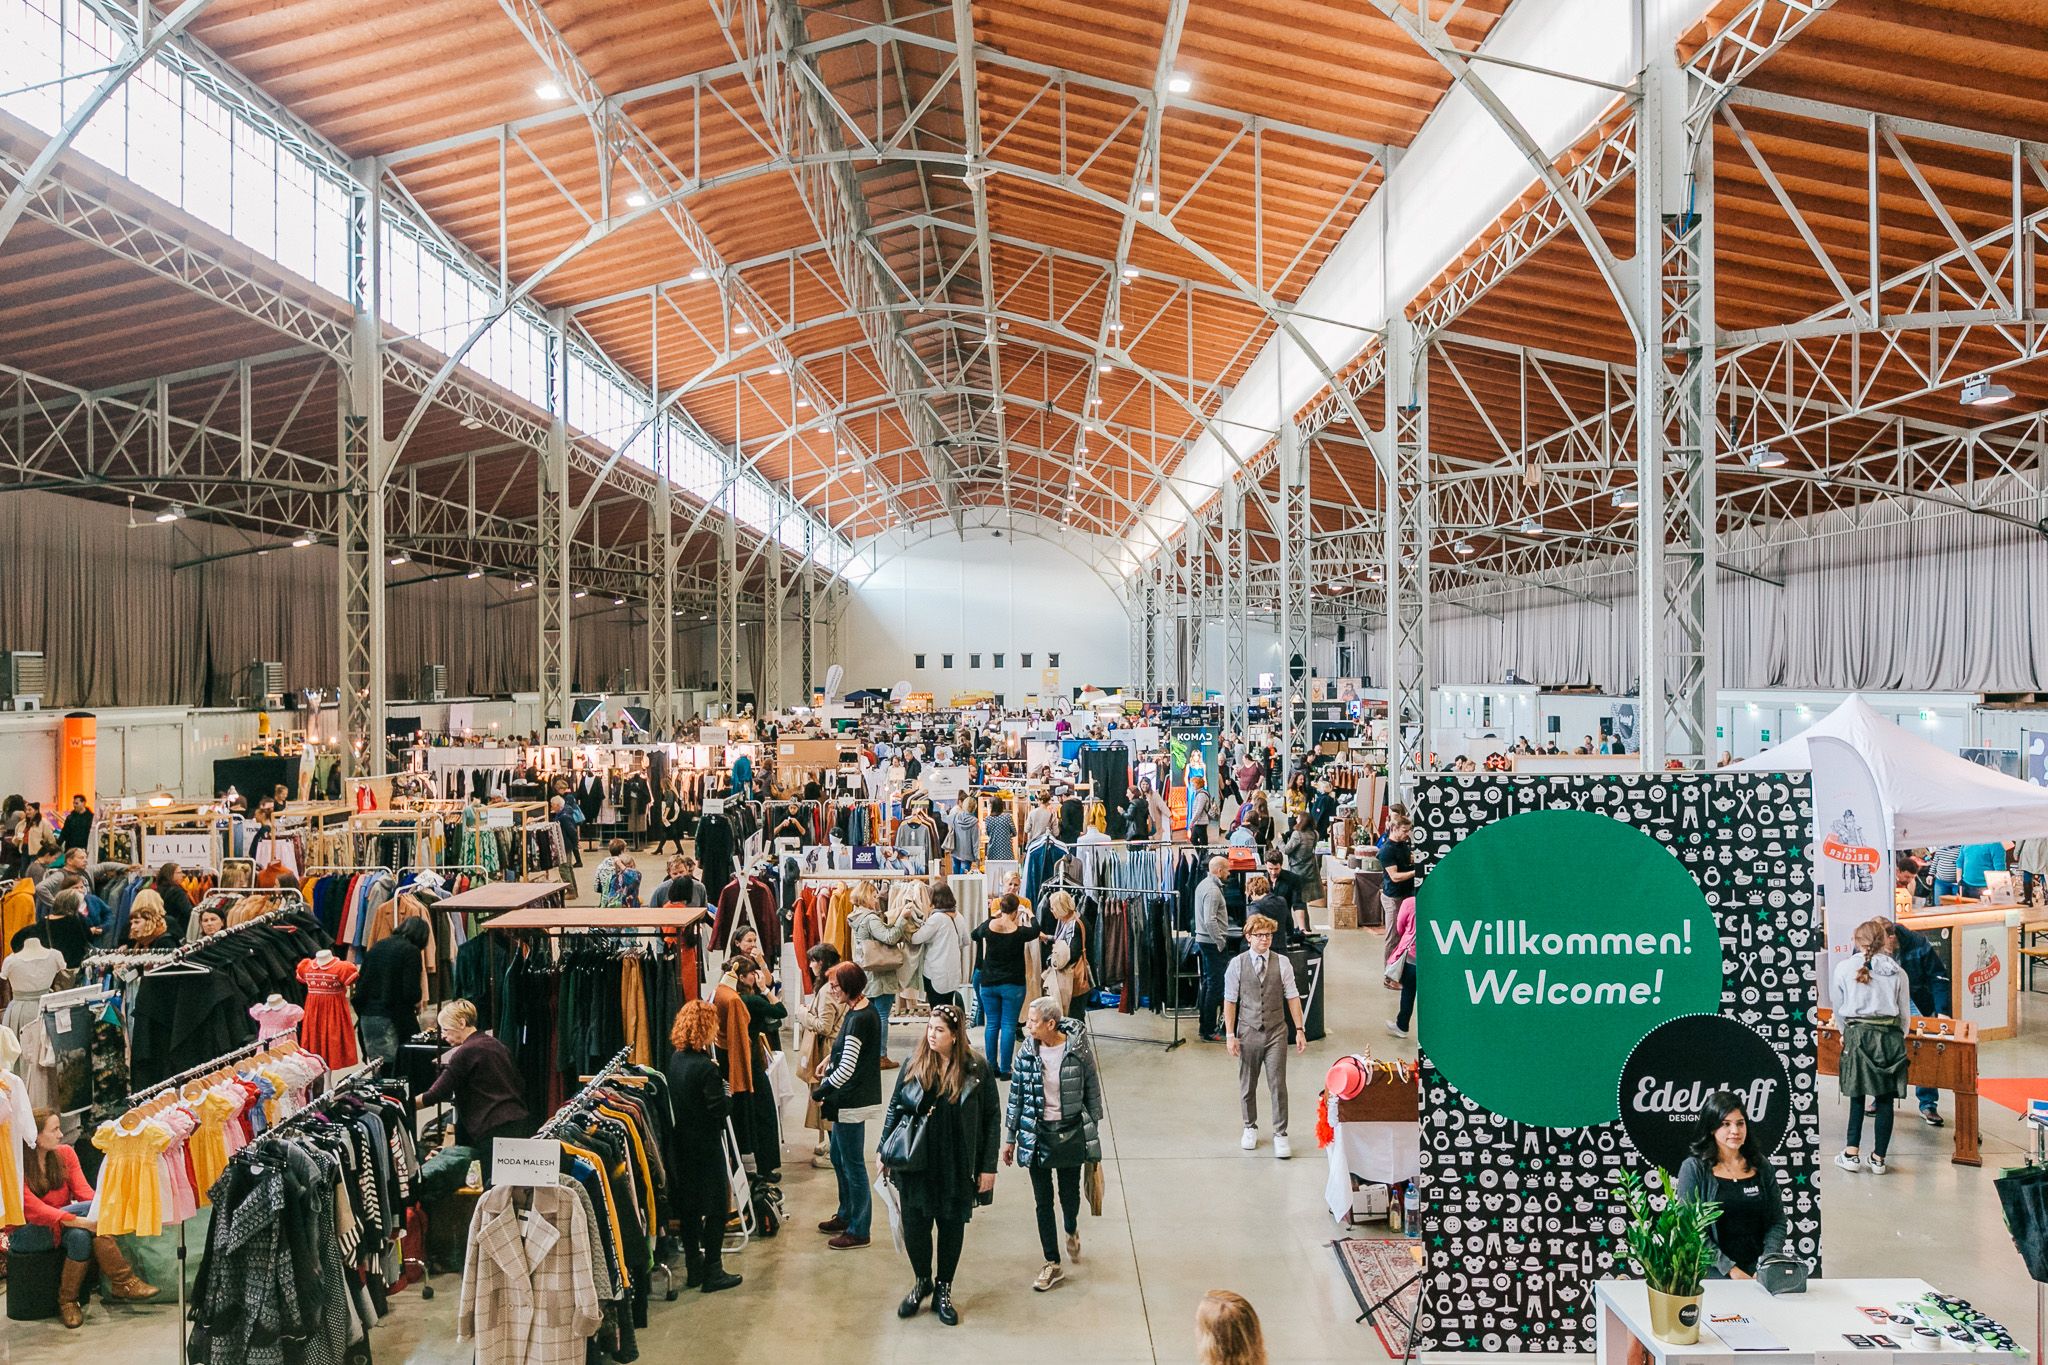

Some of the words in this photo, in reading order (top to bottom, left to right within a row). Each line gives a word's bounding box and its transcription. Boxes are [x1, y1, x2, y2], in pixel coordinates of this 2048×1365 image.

[148, 843, 206, 854] TALIA
[1429, 918, 1692, 956] Willkommen!
[1973, 968, 1998, 983] BELGIER
[1464, 968, 1664, 1005] Welcome!
[497, 1158, 521, 1166] MODA
[523, 1159, 555, 1167] MALESH
